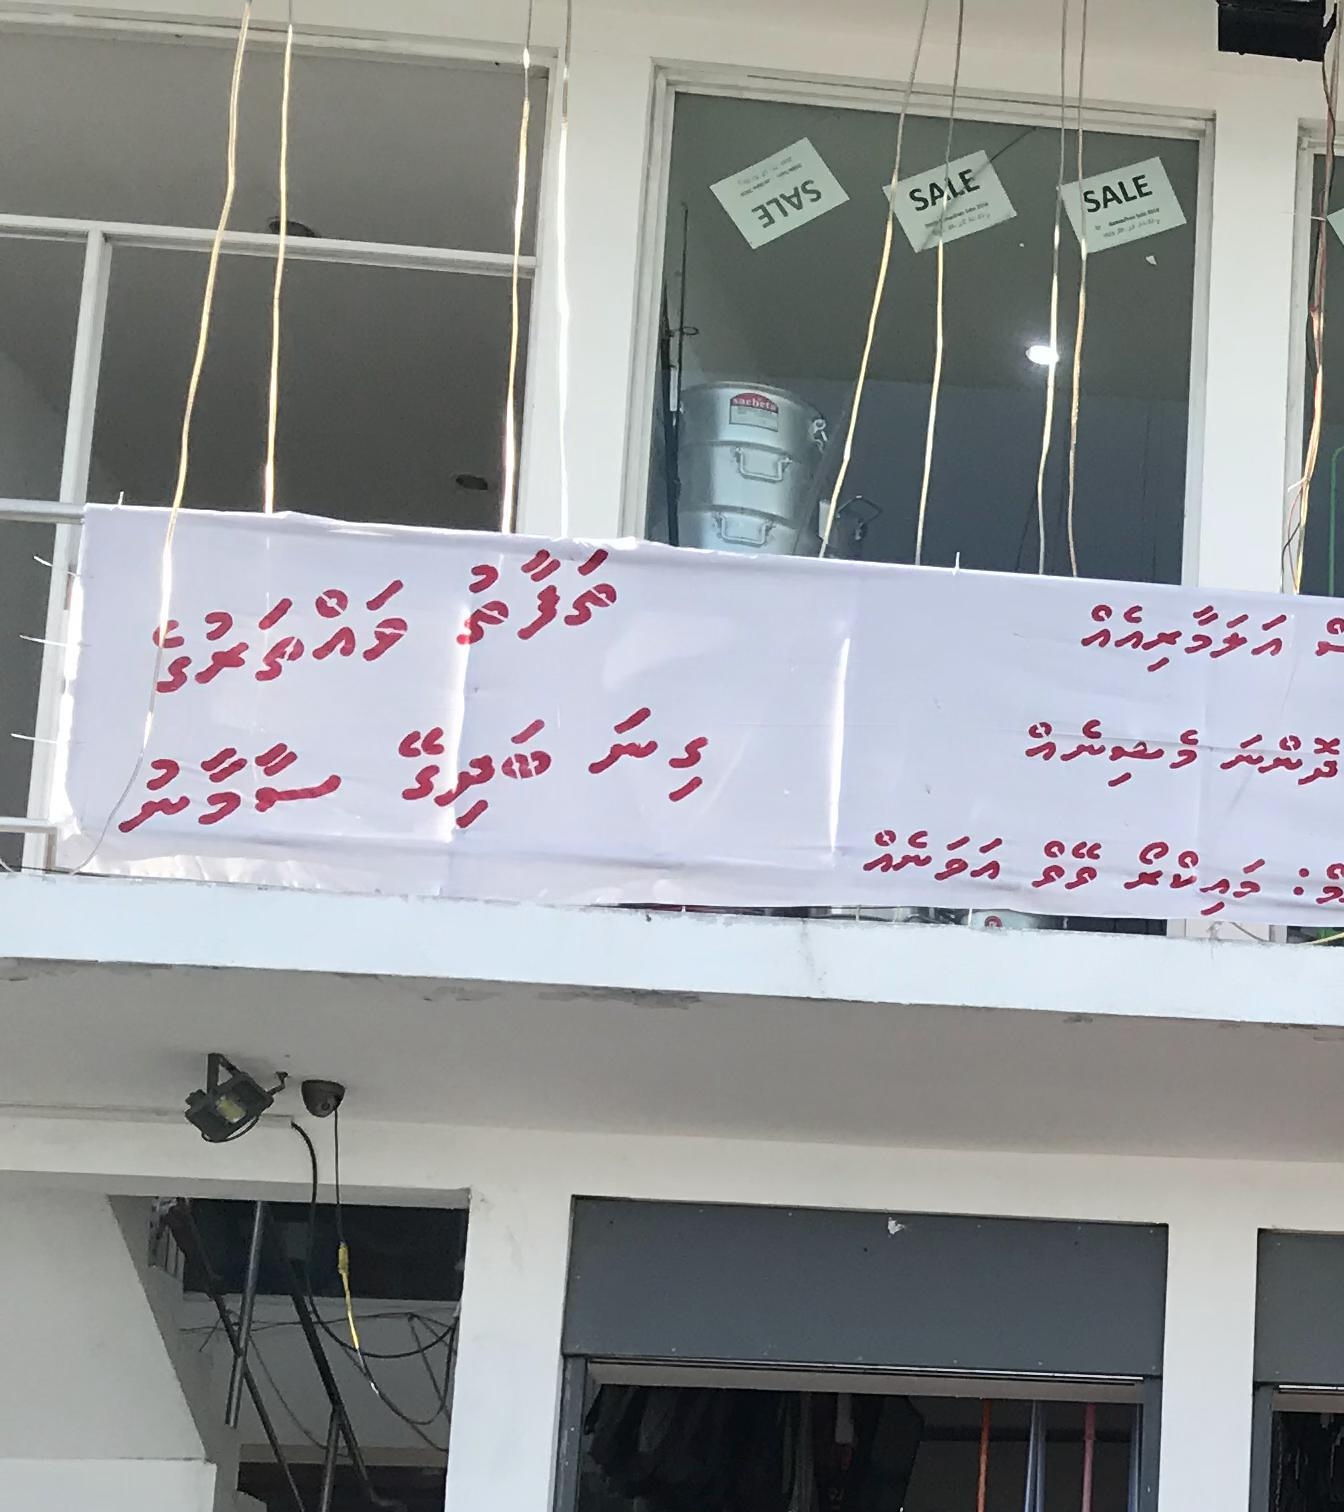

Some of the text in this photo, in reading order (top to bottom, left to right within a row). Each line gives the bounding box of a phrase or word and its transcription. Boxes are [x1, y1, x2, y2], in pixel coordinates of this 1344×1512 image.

[751, 179, 823, 229] SALE
[909, 168, 981, 211] SALE
[1082, 174, 1153, 213] SALE
[589, 708, 707, 801] ގިނަ
